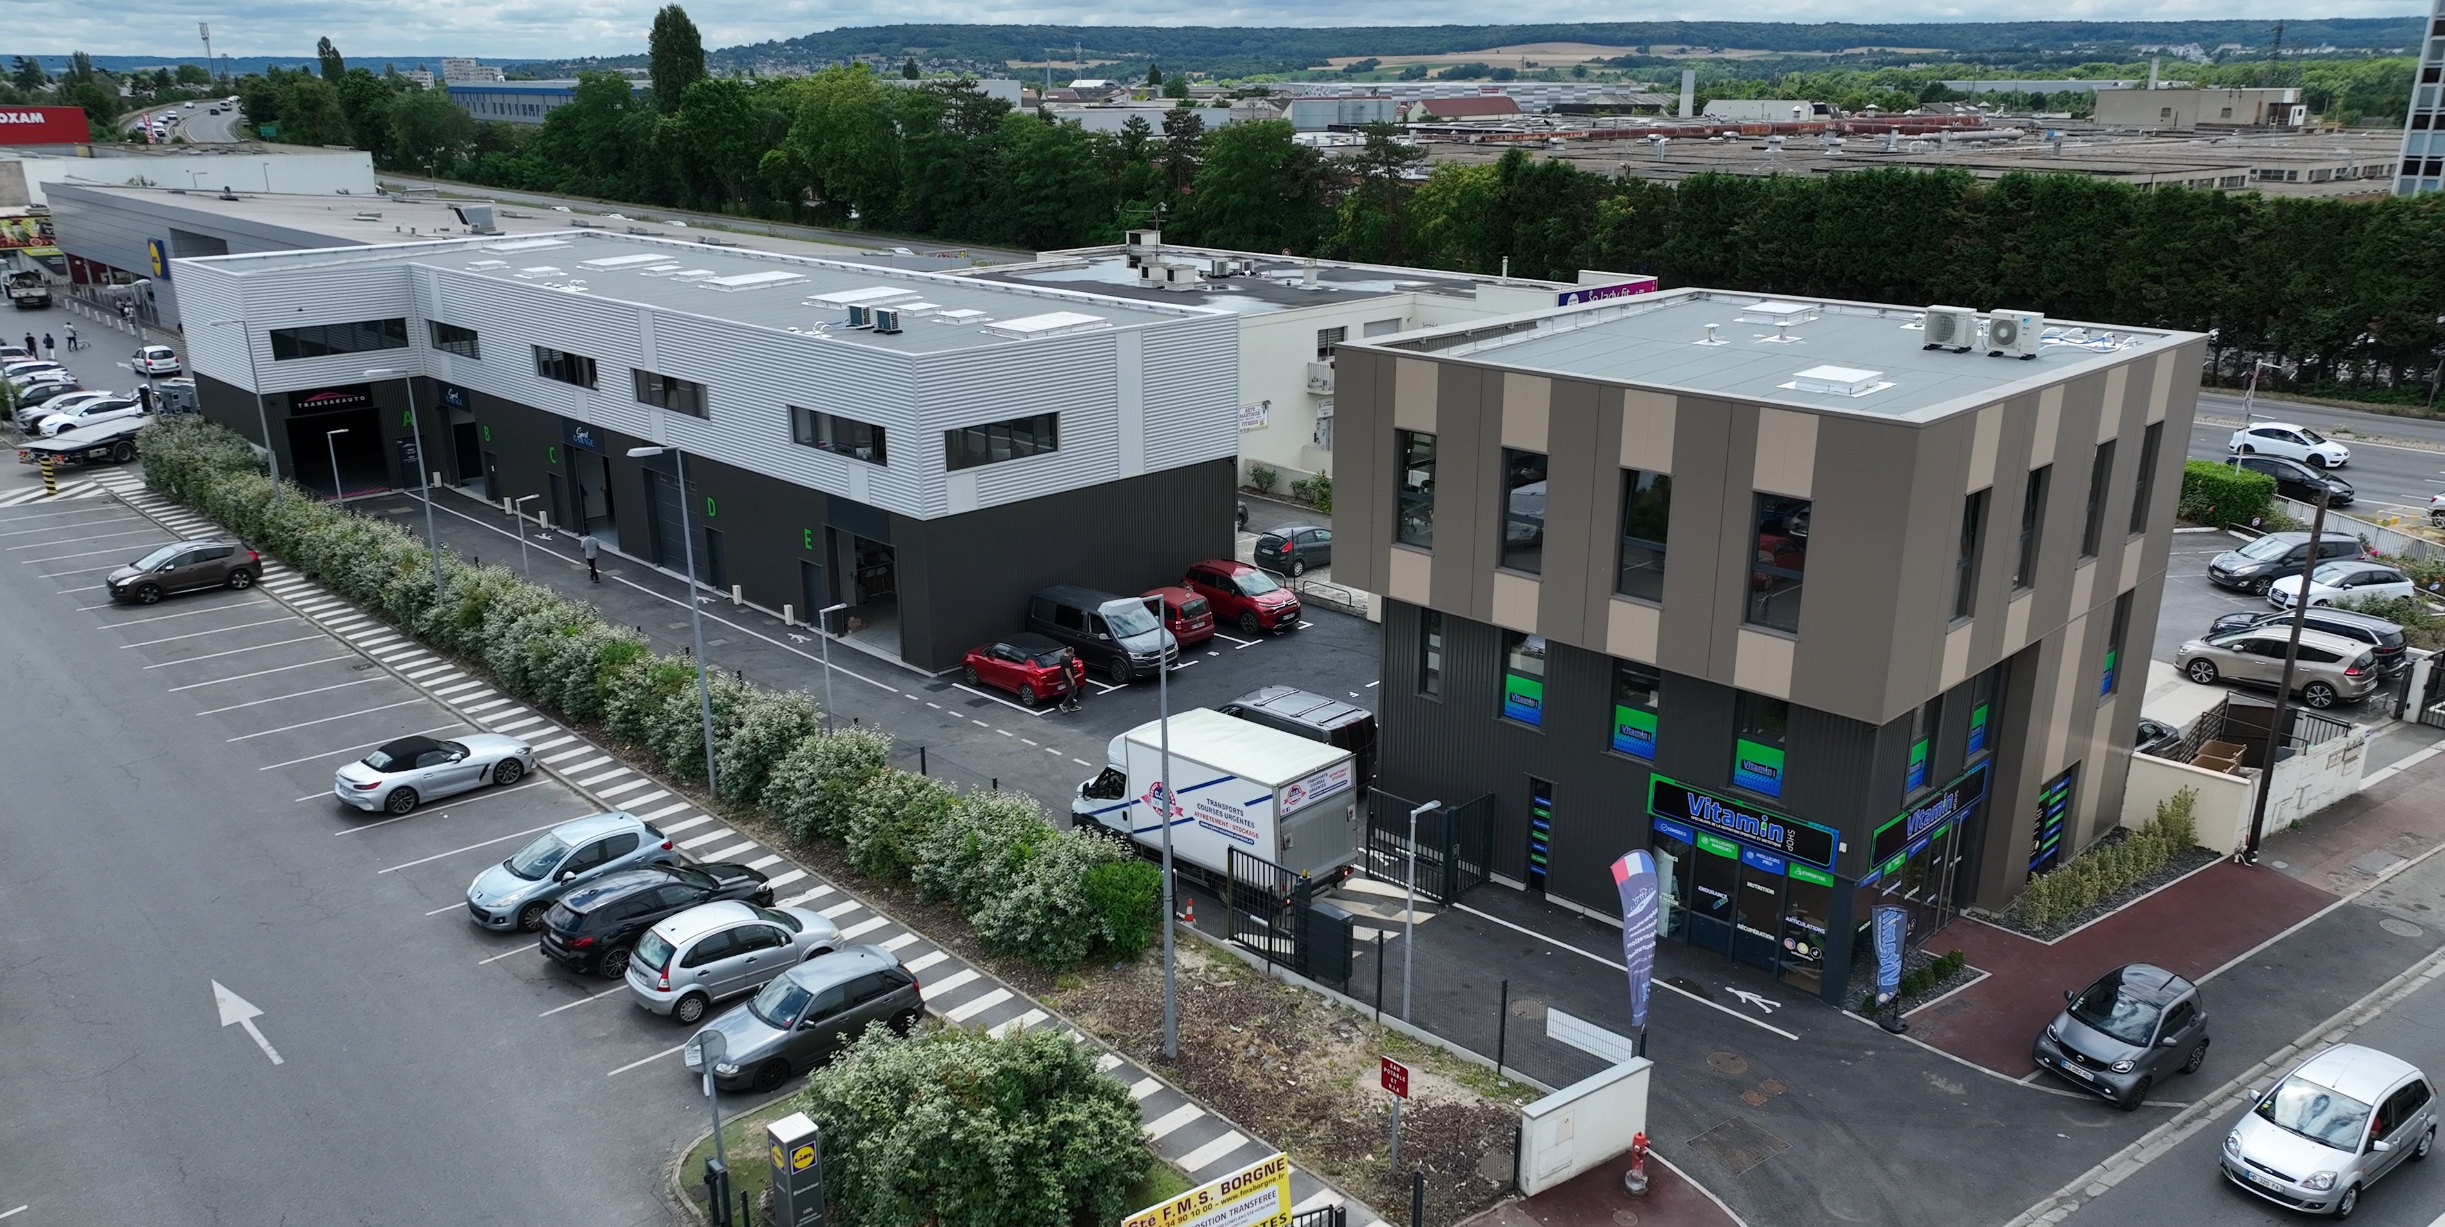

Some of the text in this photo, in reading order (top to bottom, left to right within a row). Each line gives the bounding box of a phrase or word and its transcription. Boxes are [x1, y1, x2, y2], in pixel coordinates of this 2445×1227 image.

[297, 395, 366, 409] TRANSAKAUTO
[402, 410, 415, 427] A
[483, 425, 491, 442] B
[549, 446, 557, 464] C
[707, 496, 716, 517] D
[803, 528, 813, 550] E
[1196, 803, 1255, 829] COURSES URGENTES
[1206, 798, 1244, 817] TRANSPORTS
[1907, 791, 1954, 837] Vitamin
[1687, 792, 1785, 843] Vitamin
[1232, 824, 1260, 839] STOCKAGE
[1785, 828, 1796, 852] SHOP
[1709, 837, 1735, 849] MEILLEURES
[1711, 842, 1733, 853] MARQUES
[1755, 852, 1781, 864] MEILLEURS
[1801, 870, 1826, 882] EXPERTISE
[1698, 885, 1728, 899] ENDURANCE
[1746, 881, 1775, 895] NUTRITION
[1785, 915, 1826, 934] ARTICULATIONS
[1383, 1066, 1406, 1082] POTABLE
[1389, 1063, 1401, 1072] EAU
[1390, 1077, 1397, 1085] ET
[1220, 1157, 1285, 1196] BORGNE
[1178, 1214, 1188, 1224] 90
[1190, 1208, 1201, 1218] 10
[1202, 1203, 1213, 1213] 00
[1220, 1173, 1285, 1205] www.fmsborgne.fr
[1191, 1189, 1277, 1227] OSITION TRANSFEREE
